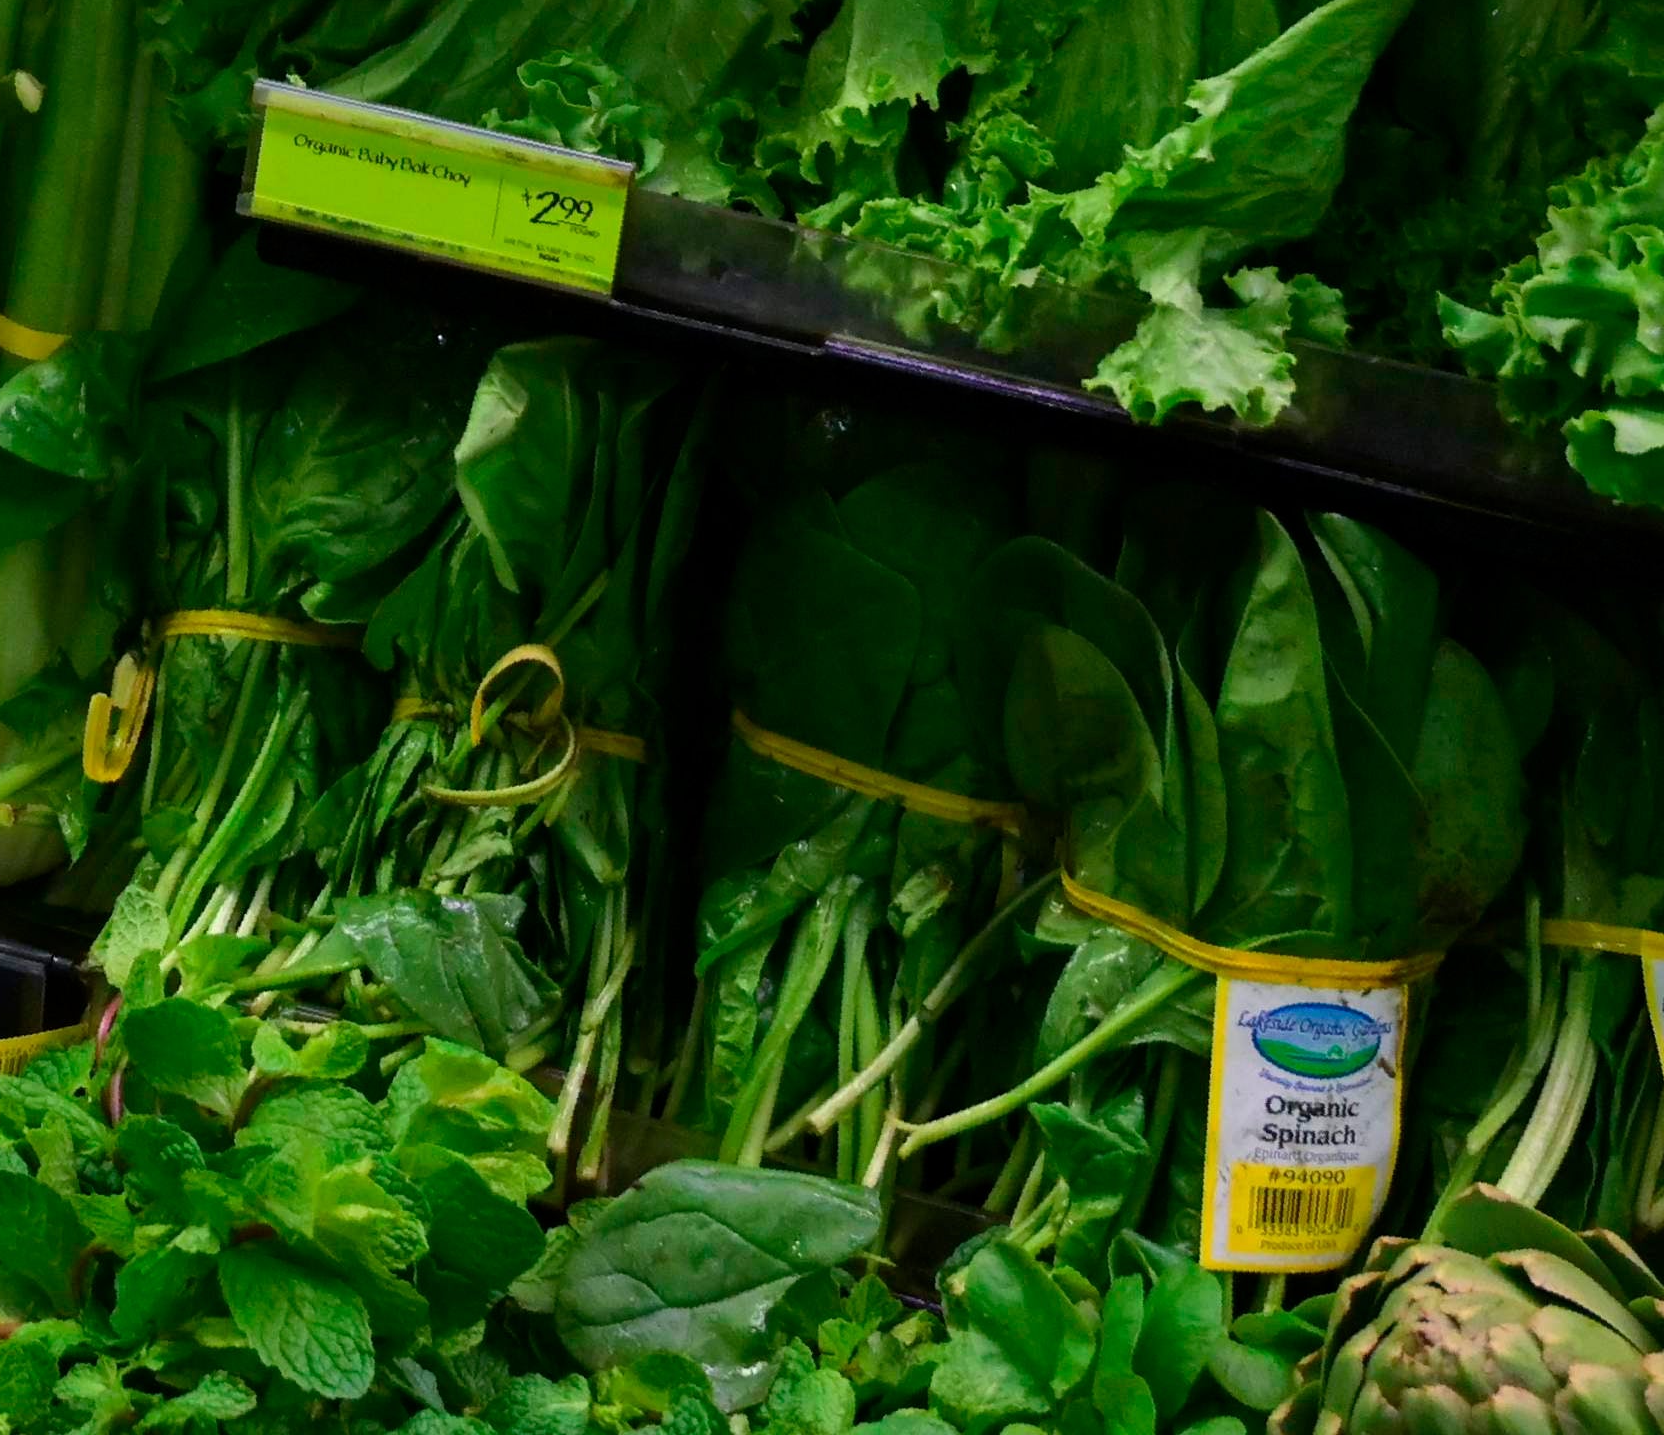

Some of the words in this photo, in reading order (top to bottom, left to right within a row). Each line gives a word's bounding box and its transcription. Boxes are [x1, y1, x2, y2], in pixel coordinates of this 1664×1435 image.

[294, 133, 355, 159] Organic
[357, 147, 399, 172] Baby
[400, 157, 431, 175] Bok
[432, 165, 472, 188] Choy
[1264, 1094, 1360, 1122] Organic
[1262, 1123, 1357, 1149] Spinach
[1268, 1167, 1346, 1185] #94090
